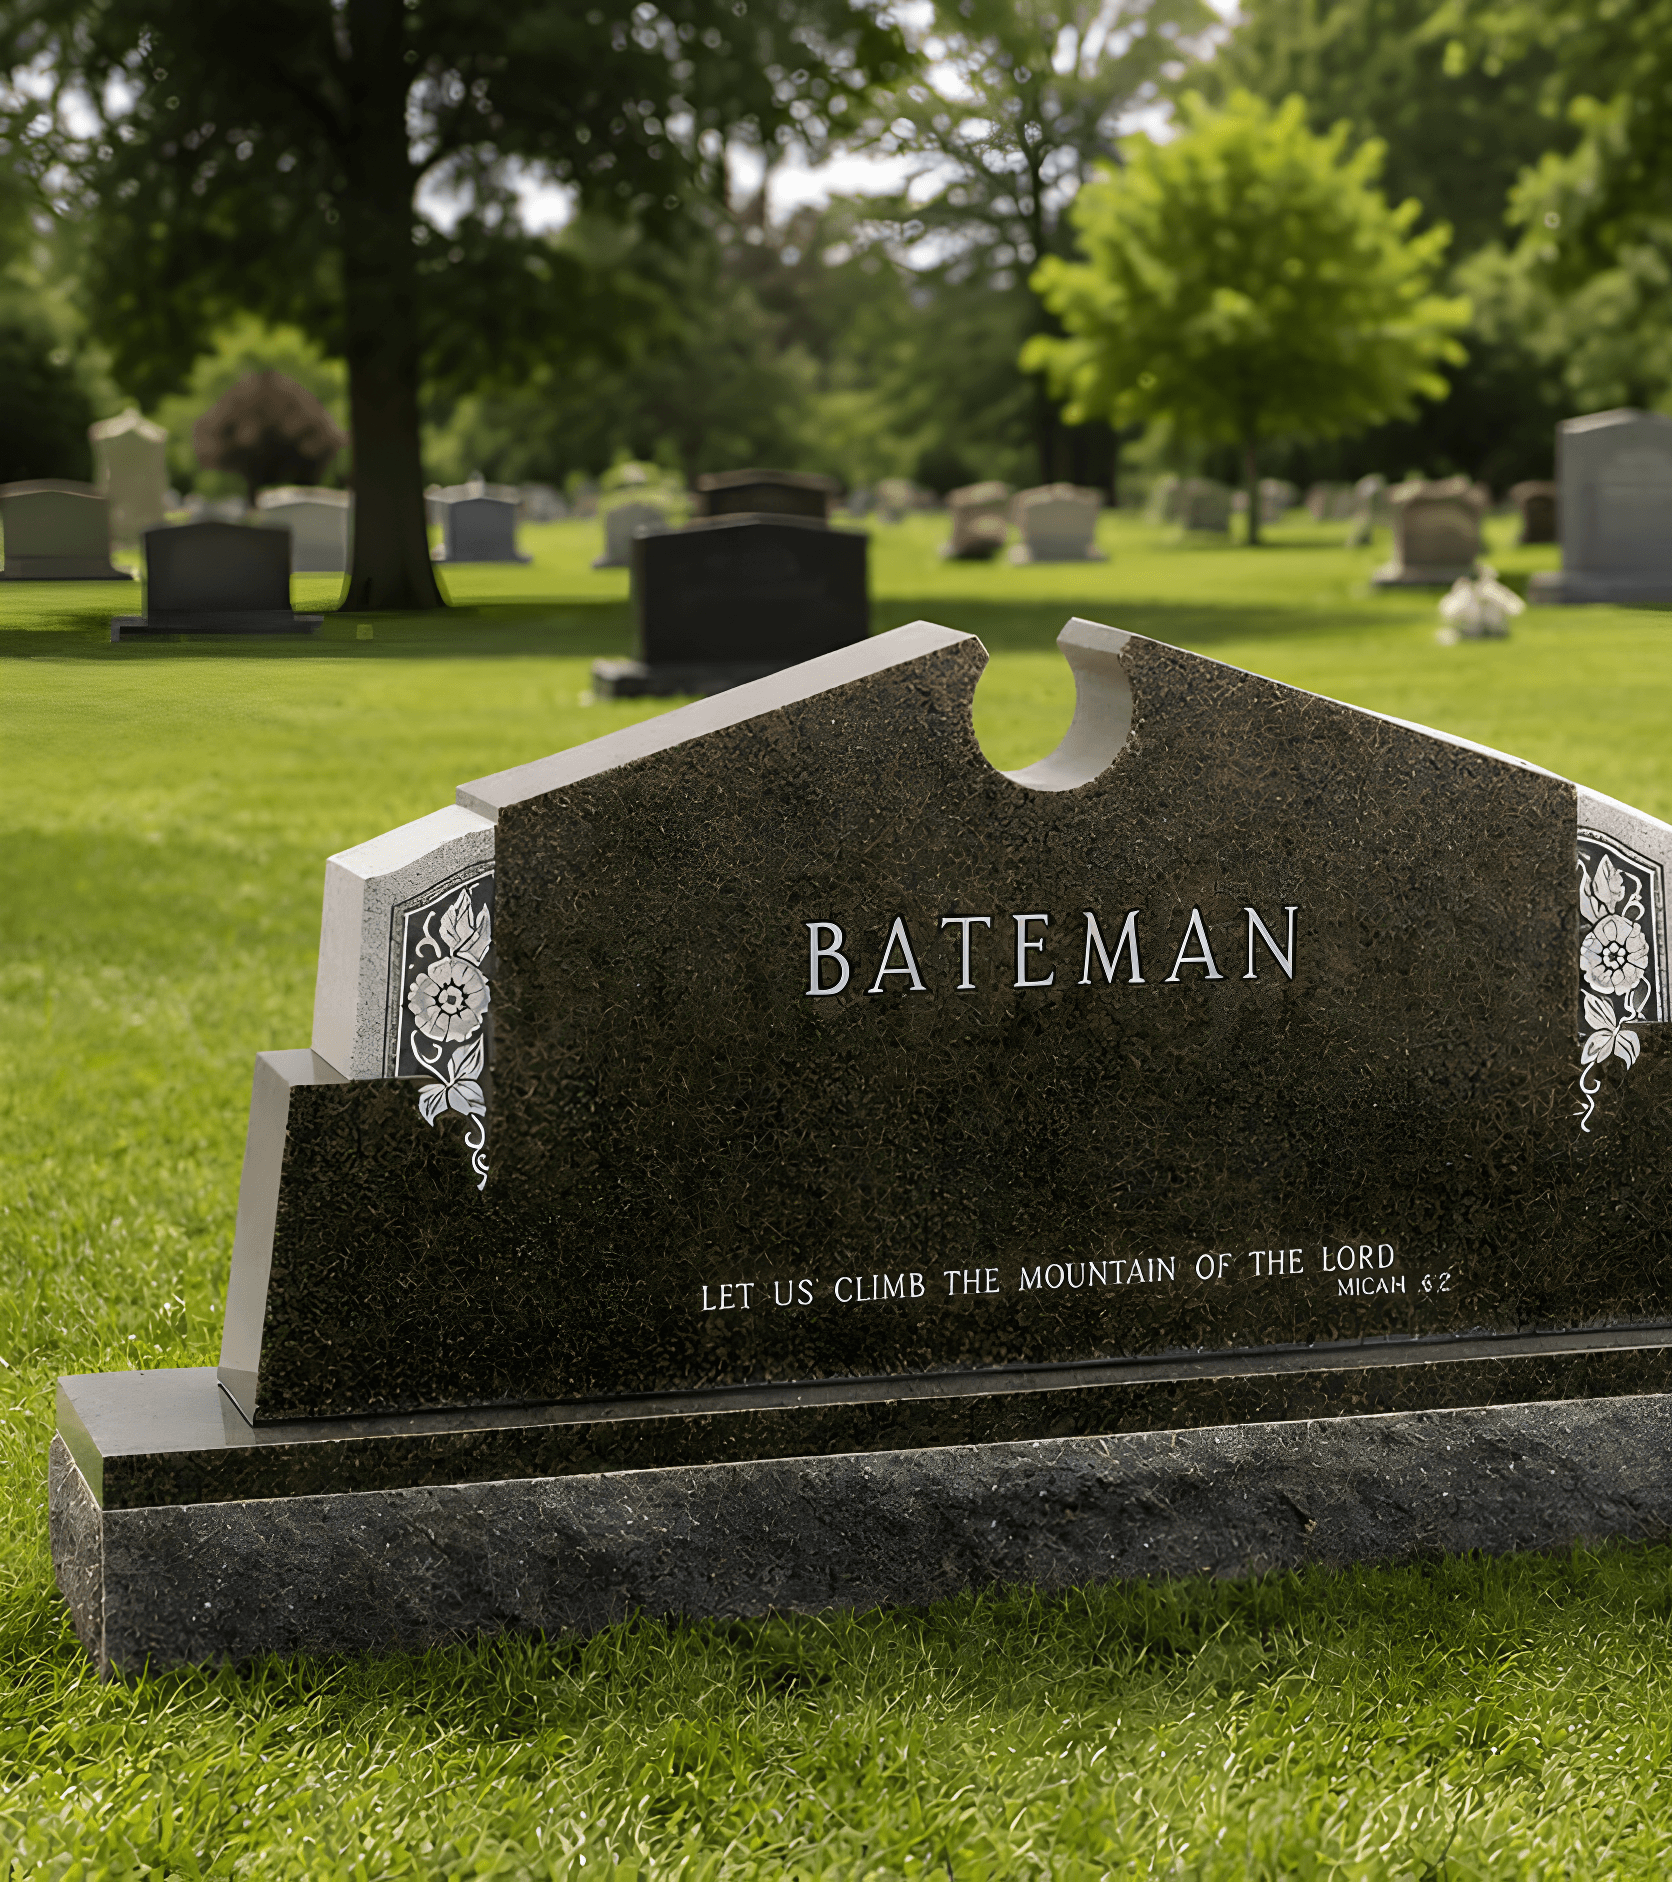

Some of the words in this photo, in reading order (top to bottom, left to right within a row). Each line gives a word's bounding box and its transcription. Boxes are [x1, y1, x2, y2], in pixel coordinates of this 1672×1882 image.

[805, 906, 1298, 997] BATEMAN
[701, 1282, 755, 1312] LET
[773, 1278, 814, 1306] US
[834, 1271, 926, 1303] CLIMB
[943, 1267, 1000, 1296] THE
[1018, 1256, 1176, 1292] MOUNTAIN
[1195, 1252, 1233, 1281] OF
[1248, 1248, 1304, 1276] THE
[1322, 1243, 1395, 1272] LORD
[1337, 1275, 1406, 1296] MICAH
